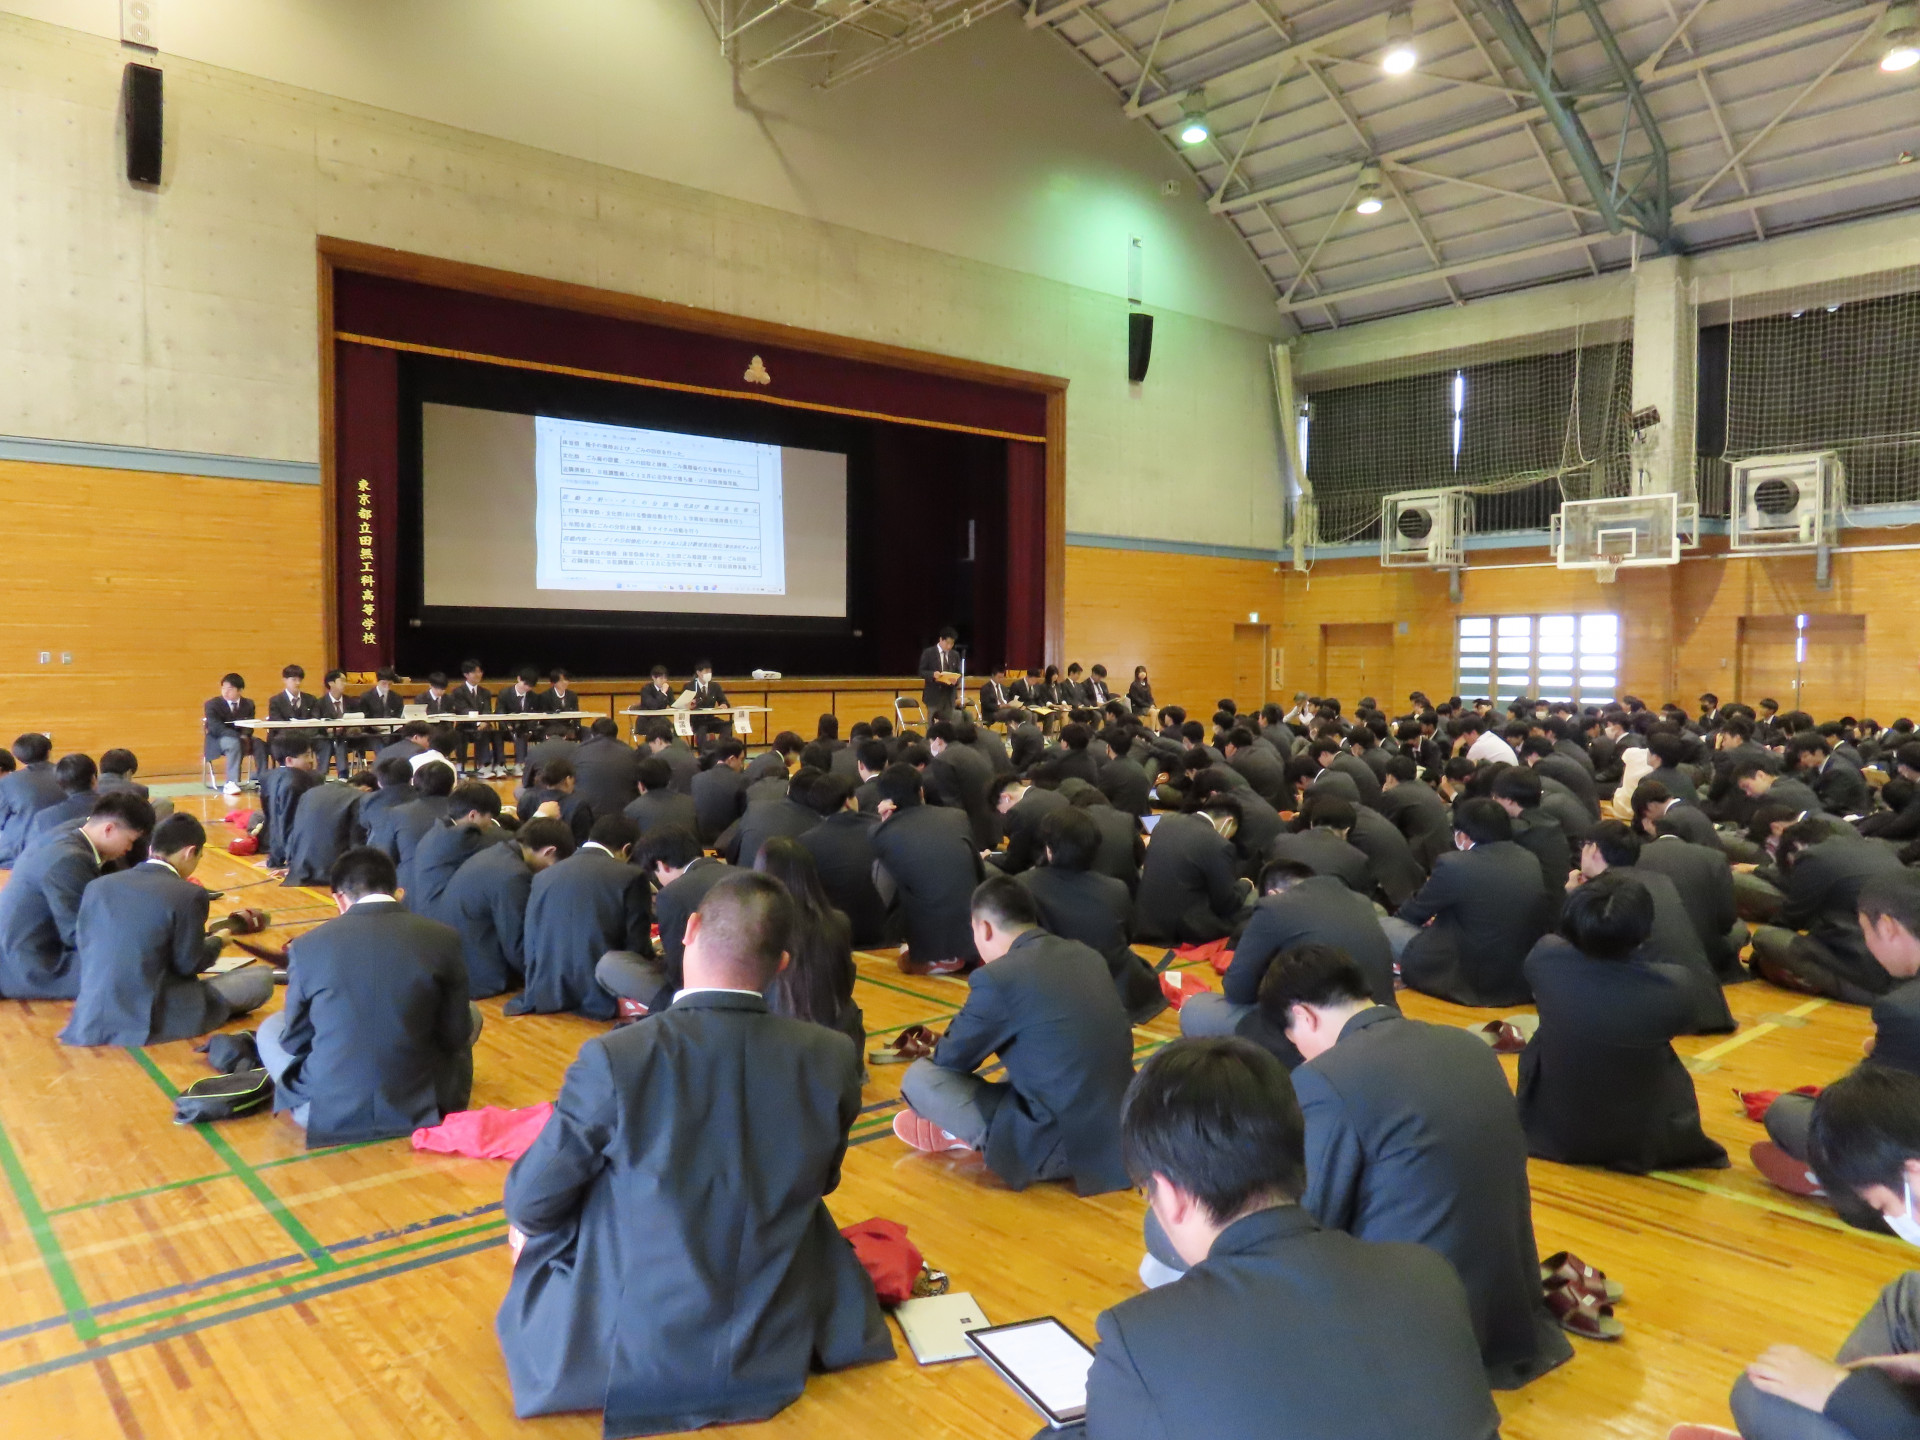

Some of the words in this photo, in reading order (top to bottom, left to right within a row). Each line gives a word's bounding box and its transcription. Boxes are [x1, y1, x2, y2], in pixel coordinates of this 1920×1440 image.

[357, 478, 377, 645] 東京都立田無工科高等学校
